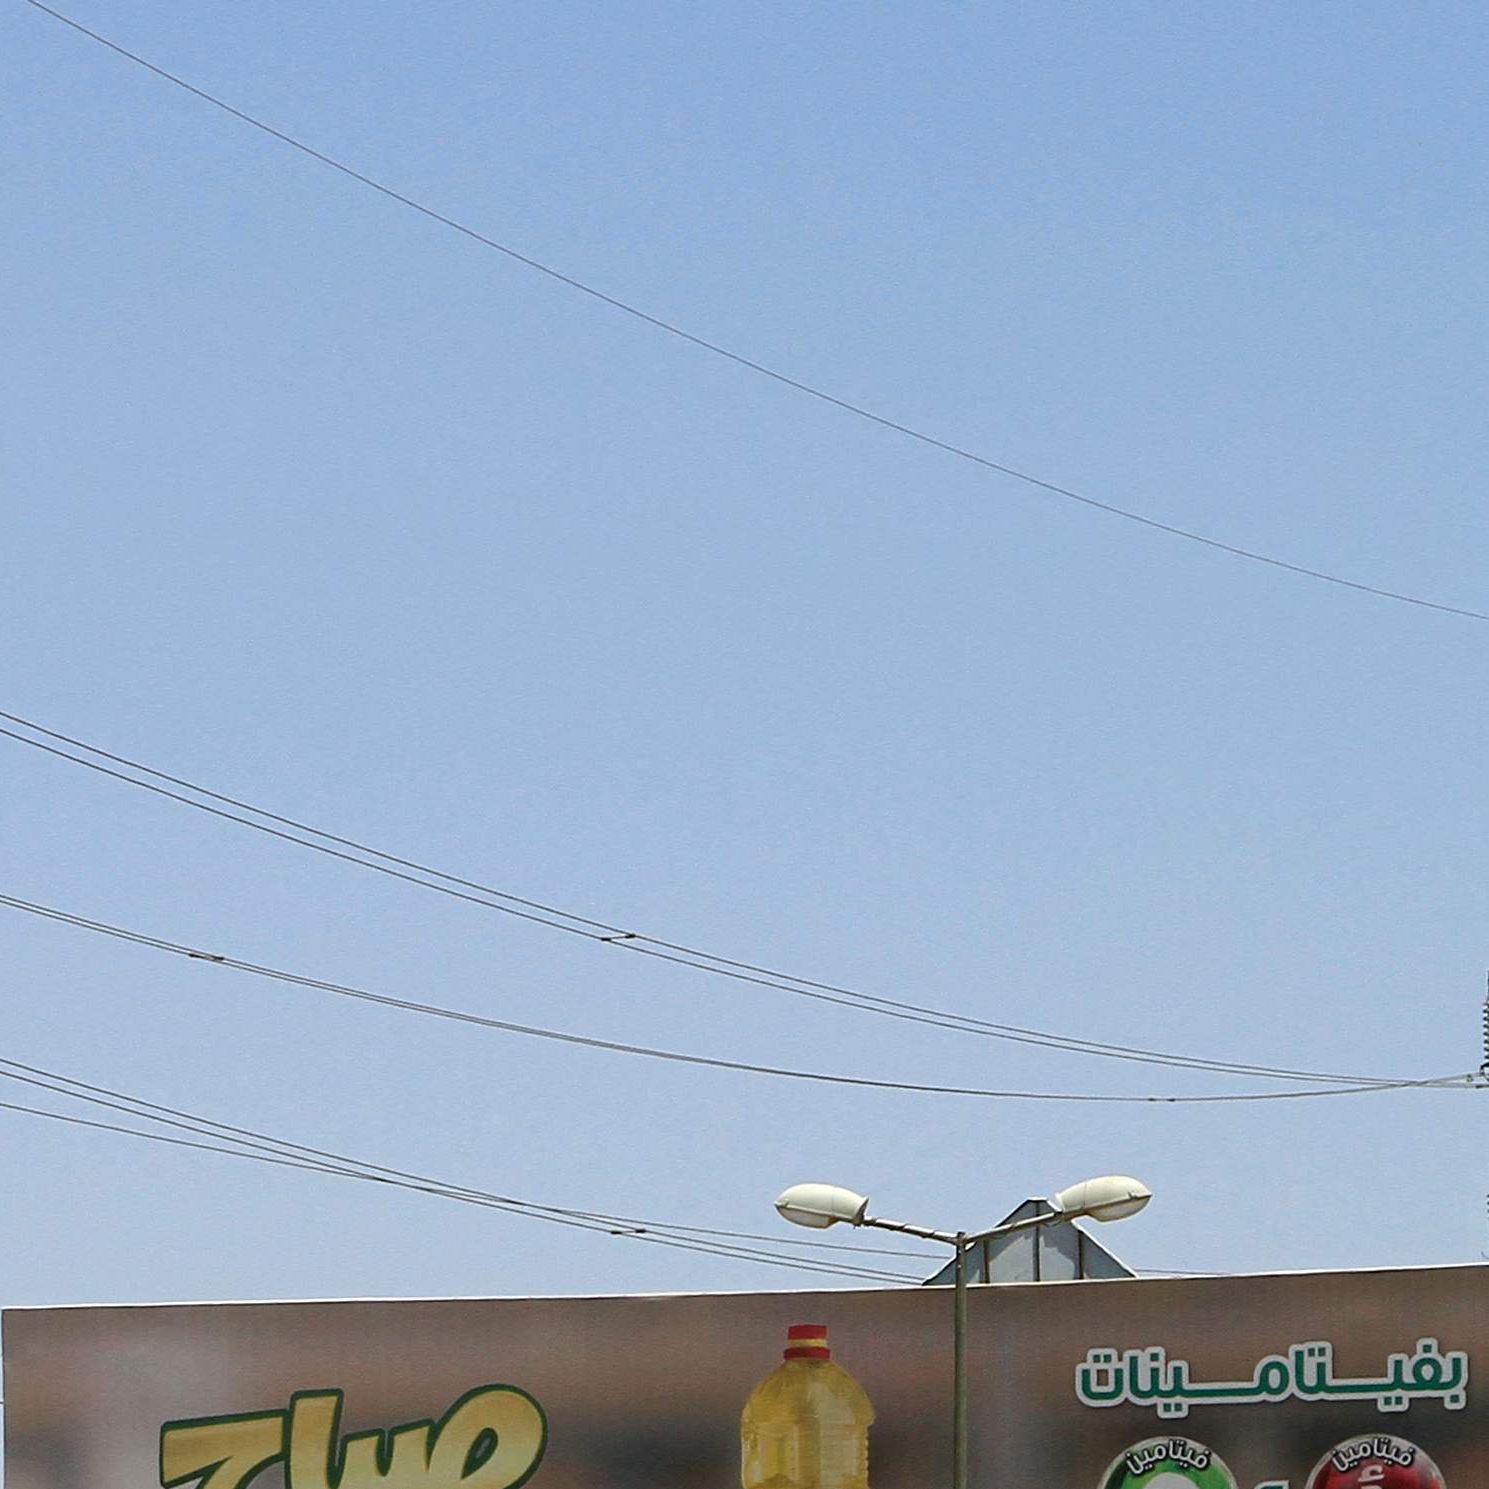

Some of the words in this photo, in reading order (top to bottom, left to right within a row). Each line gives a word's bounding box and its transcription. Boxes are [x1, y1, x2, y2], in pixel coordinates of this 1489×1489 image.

[1076, 1338, 1468, 1418] بفيتامينات
[1125, 1437, 1212, 1476] فيتامين
[1331, 1434, 1416, 1473] فيتامين
